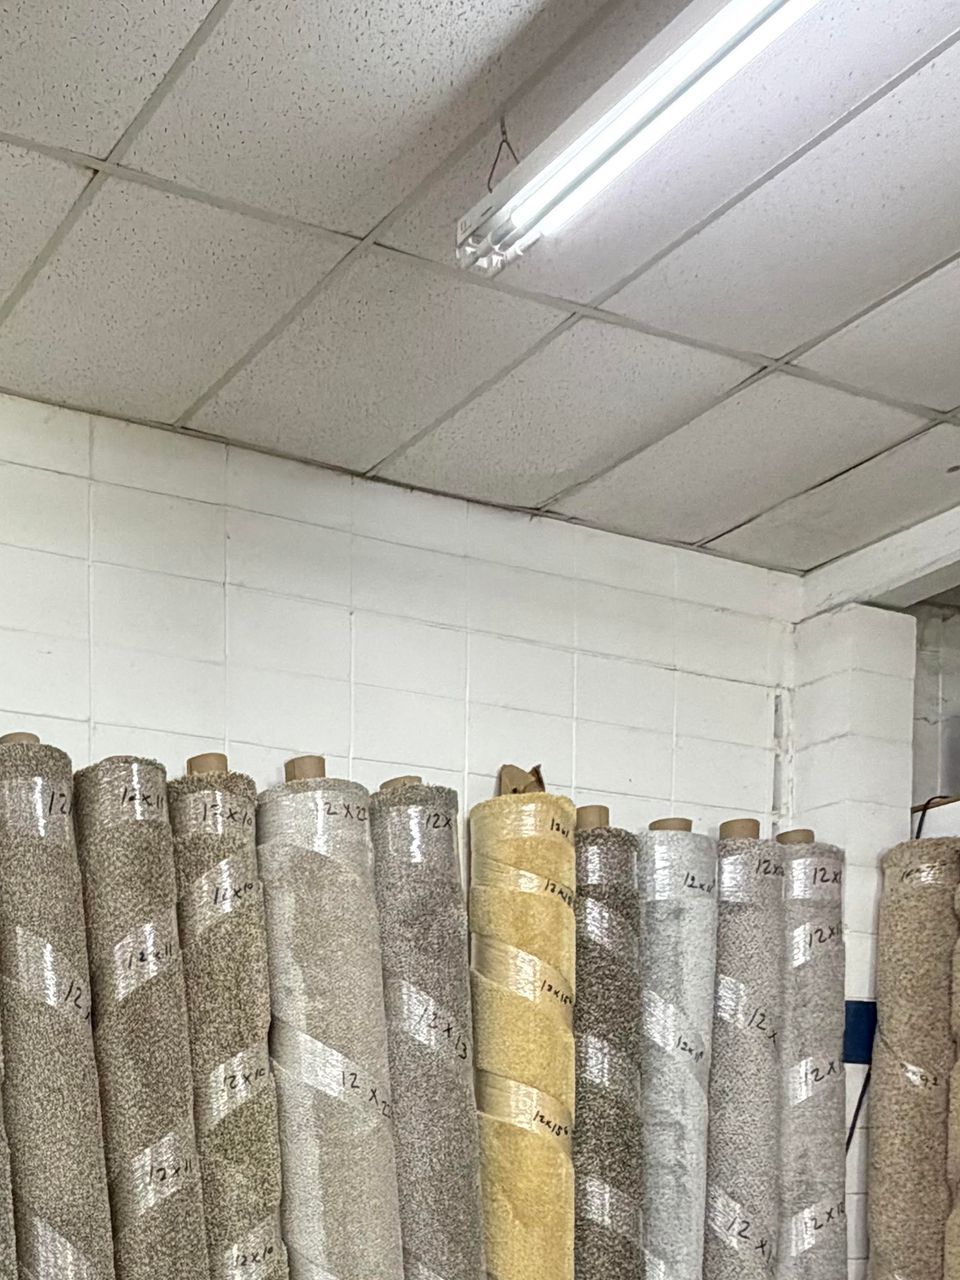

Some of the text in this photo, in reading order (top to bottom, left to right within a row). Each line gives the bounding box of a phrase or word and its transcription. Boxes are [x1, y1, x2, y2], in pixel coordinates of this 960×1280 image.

[63, 979, 83, 1010] 12
[746, 1008, 767, 1030] 12
[342, 1070, 380, 1105] 12 x
[726, 1216, 768, 1256] 12 x
